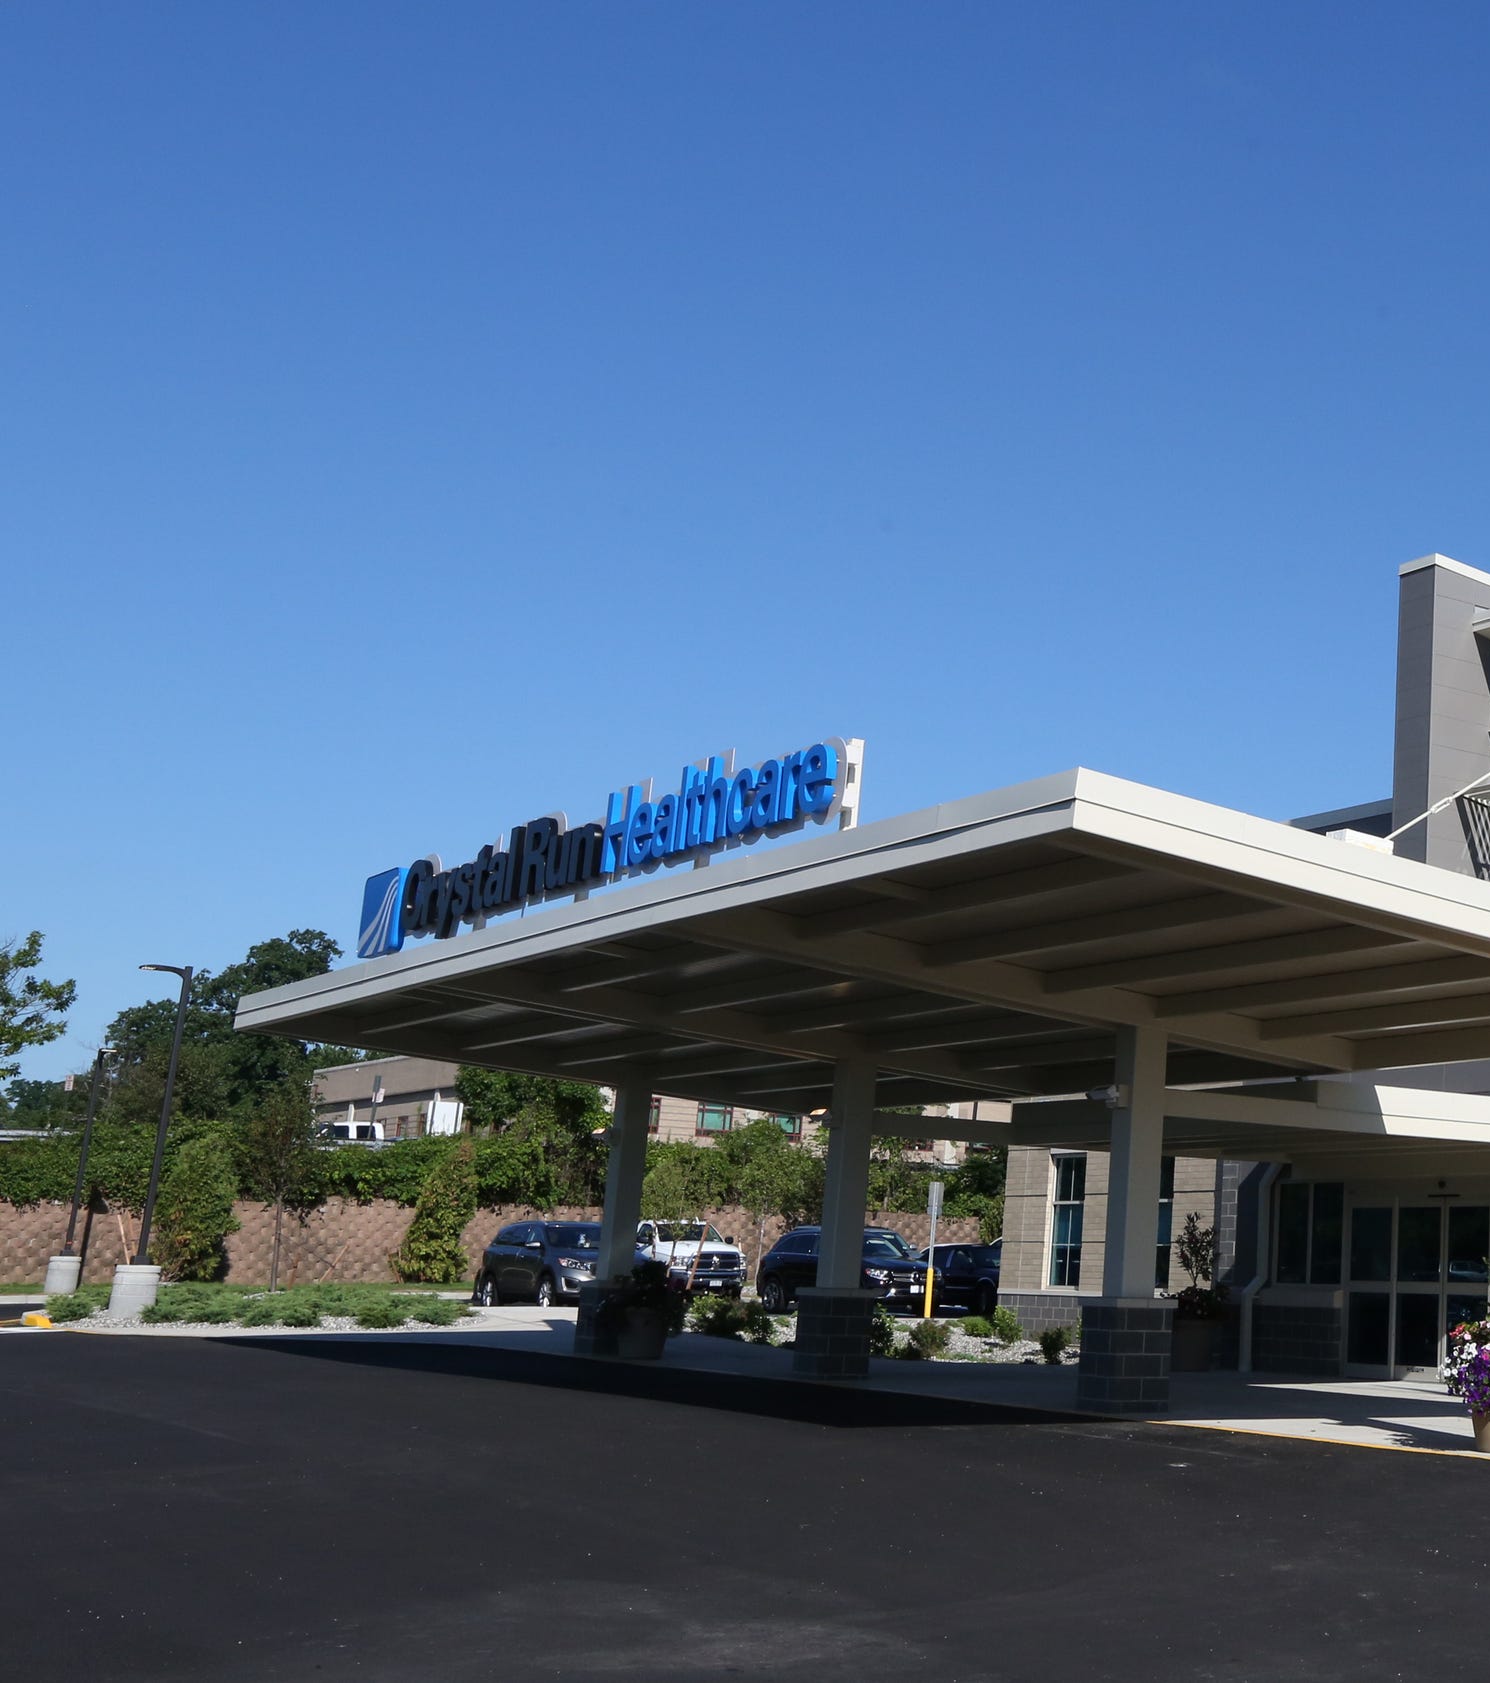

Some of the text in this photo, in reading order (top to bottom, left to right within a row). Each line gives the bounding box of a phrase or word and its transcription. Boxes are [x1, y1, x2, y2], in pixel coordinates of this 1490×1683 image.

[402, 743, 838, 939] Crystal Run Healthcare
